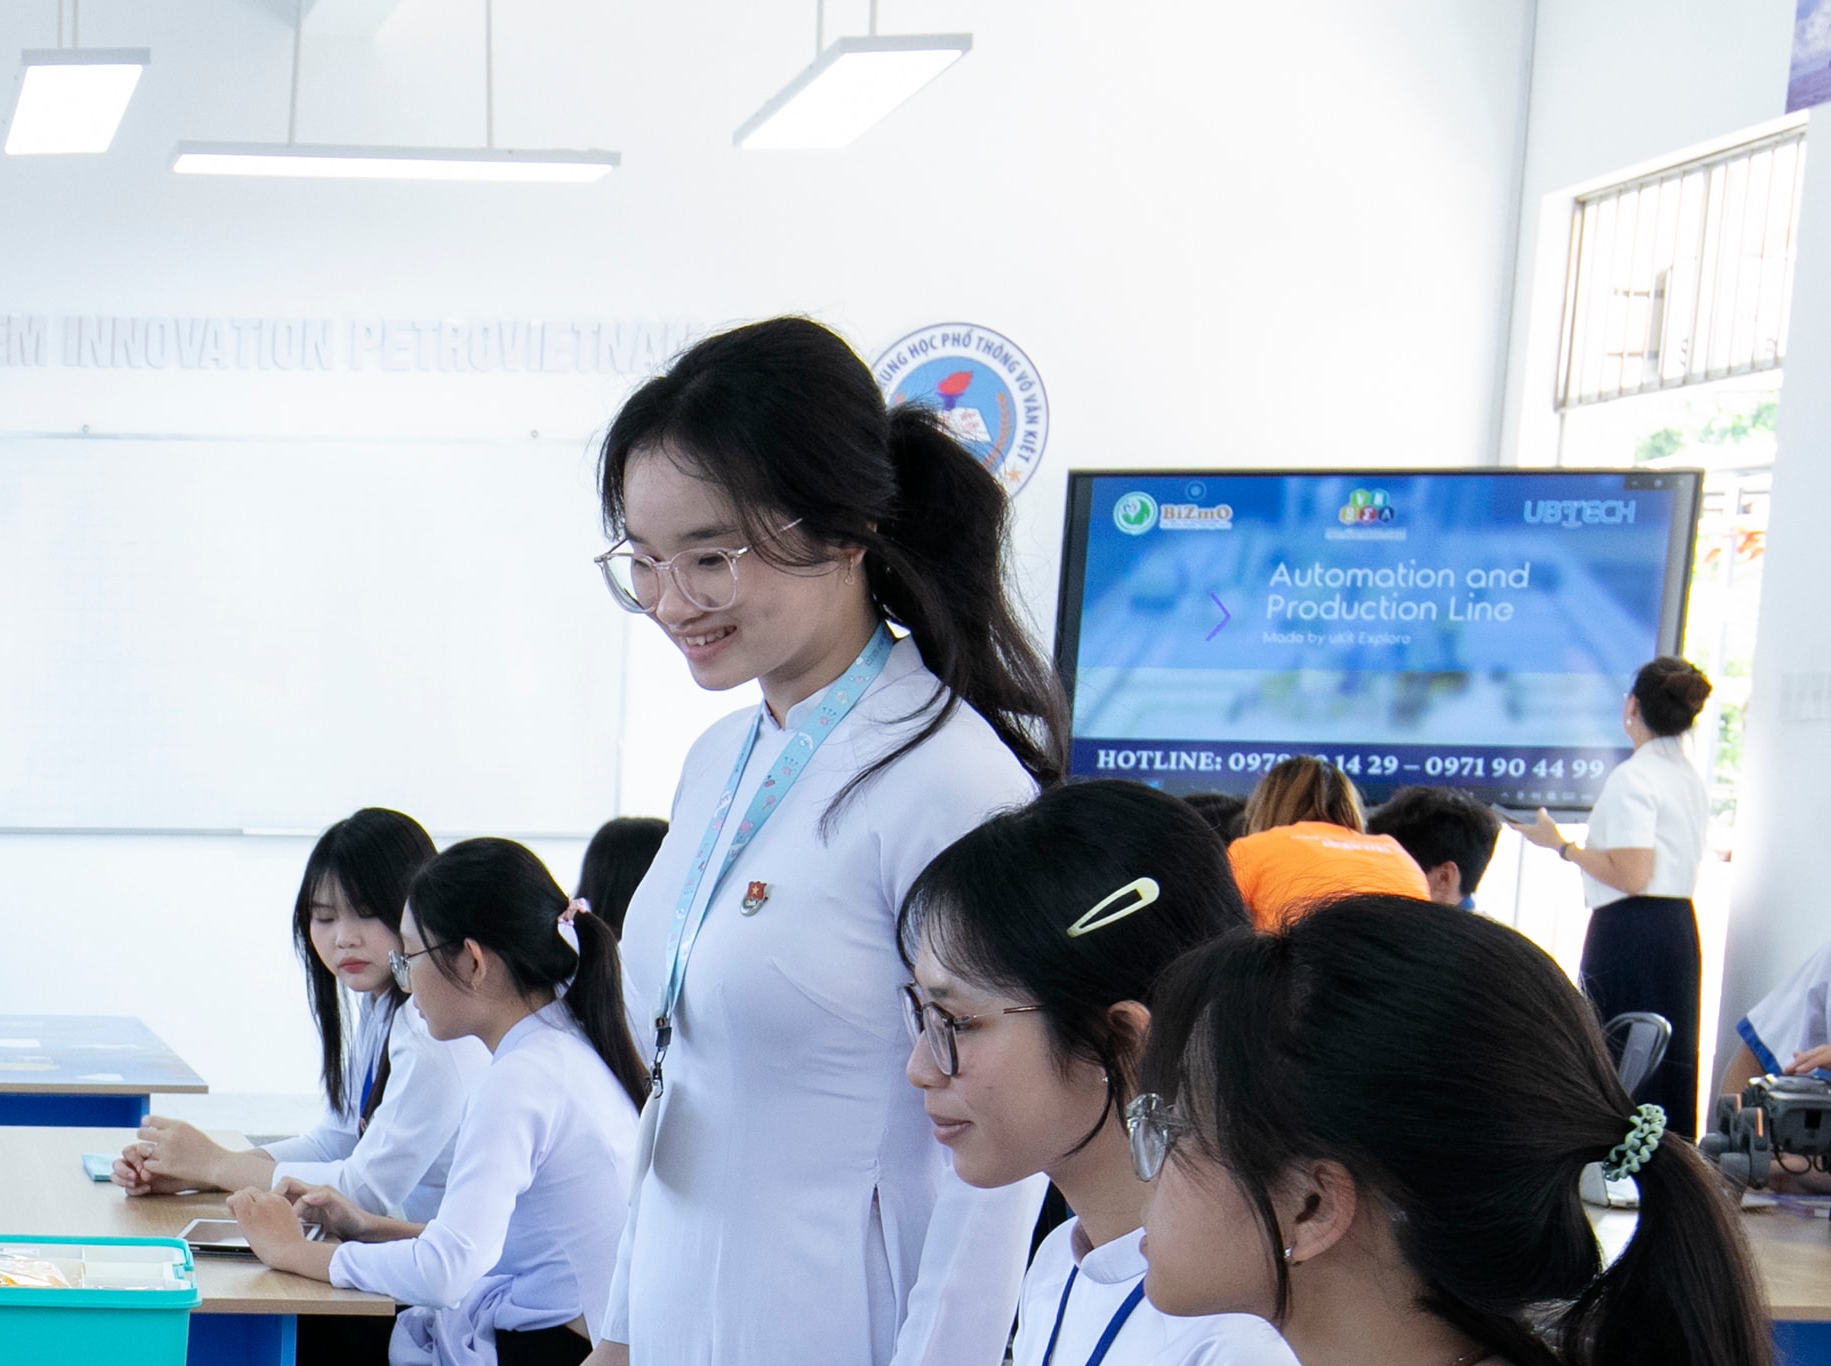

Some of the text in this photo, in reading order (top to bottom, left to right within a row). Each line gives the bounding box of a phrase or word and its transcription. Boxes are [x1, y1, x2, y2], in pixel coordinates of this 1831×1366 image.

[62, 314, 335, 371] INNOVATION
[907, 334, 939, 359] HỌC
[941, 329, 973, 348] PHỔ
[1523, 499, 1636, 527] UBTECH
[1269, 558, 1531, 588] Automation and
[1266, 592, 1515, 622] Production Line
[1096, 749, 1223, 771] HOTLINE:
[1334, 754, 1362, 775] 14
[1367, 754, 1399, 775] 29
[1425, 755, 1486, 777] 0971
[1491, 756, 1527, 778] 90
[1532, 757, 1565, 778] 44
[1571, 758, 1605, 780] 99
